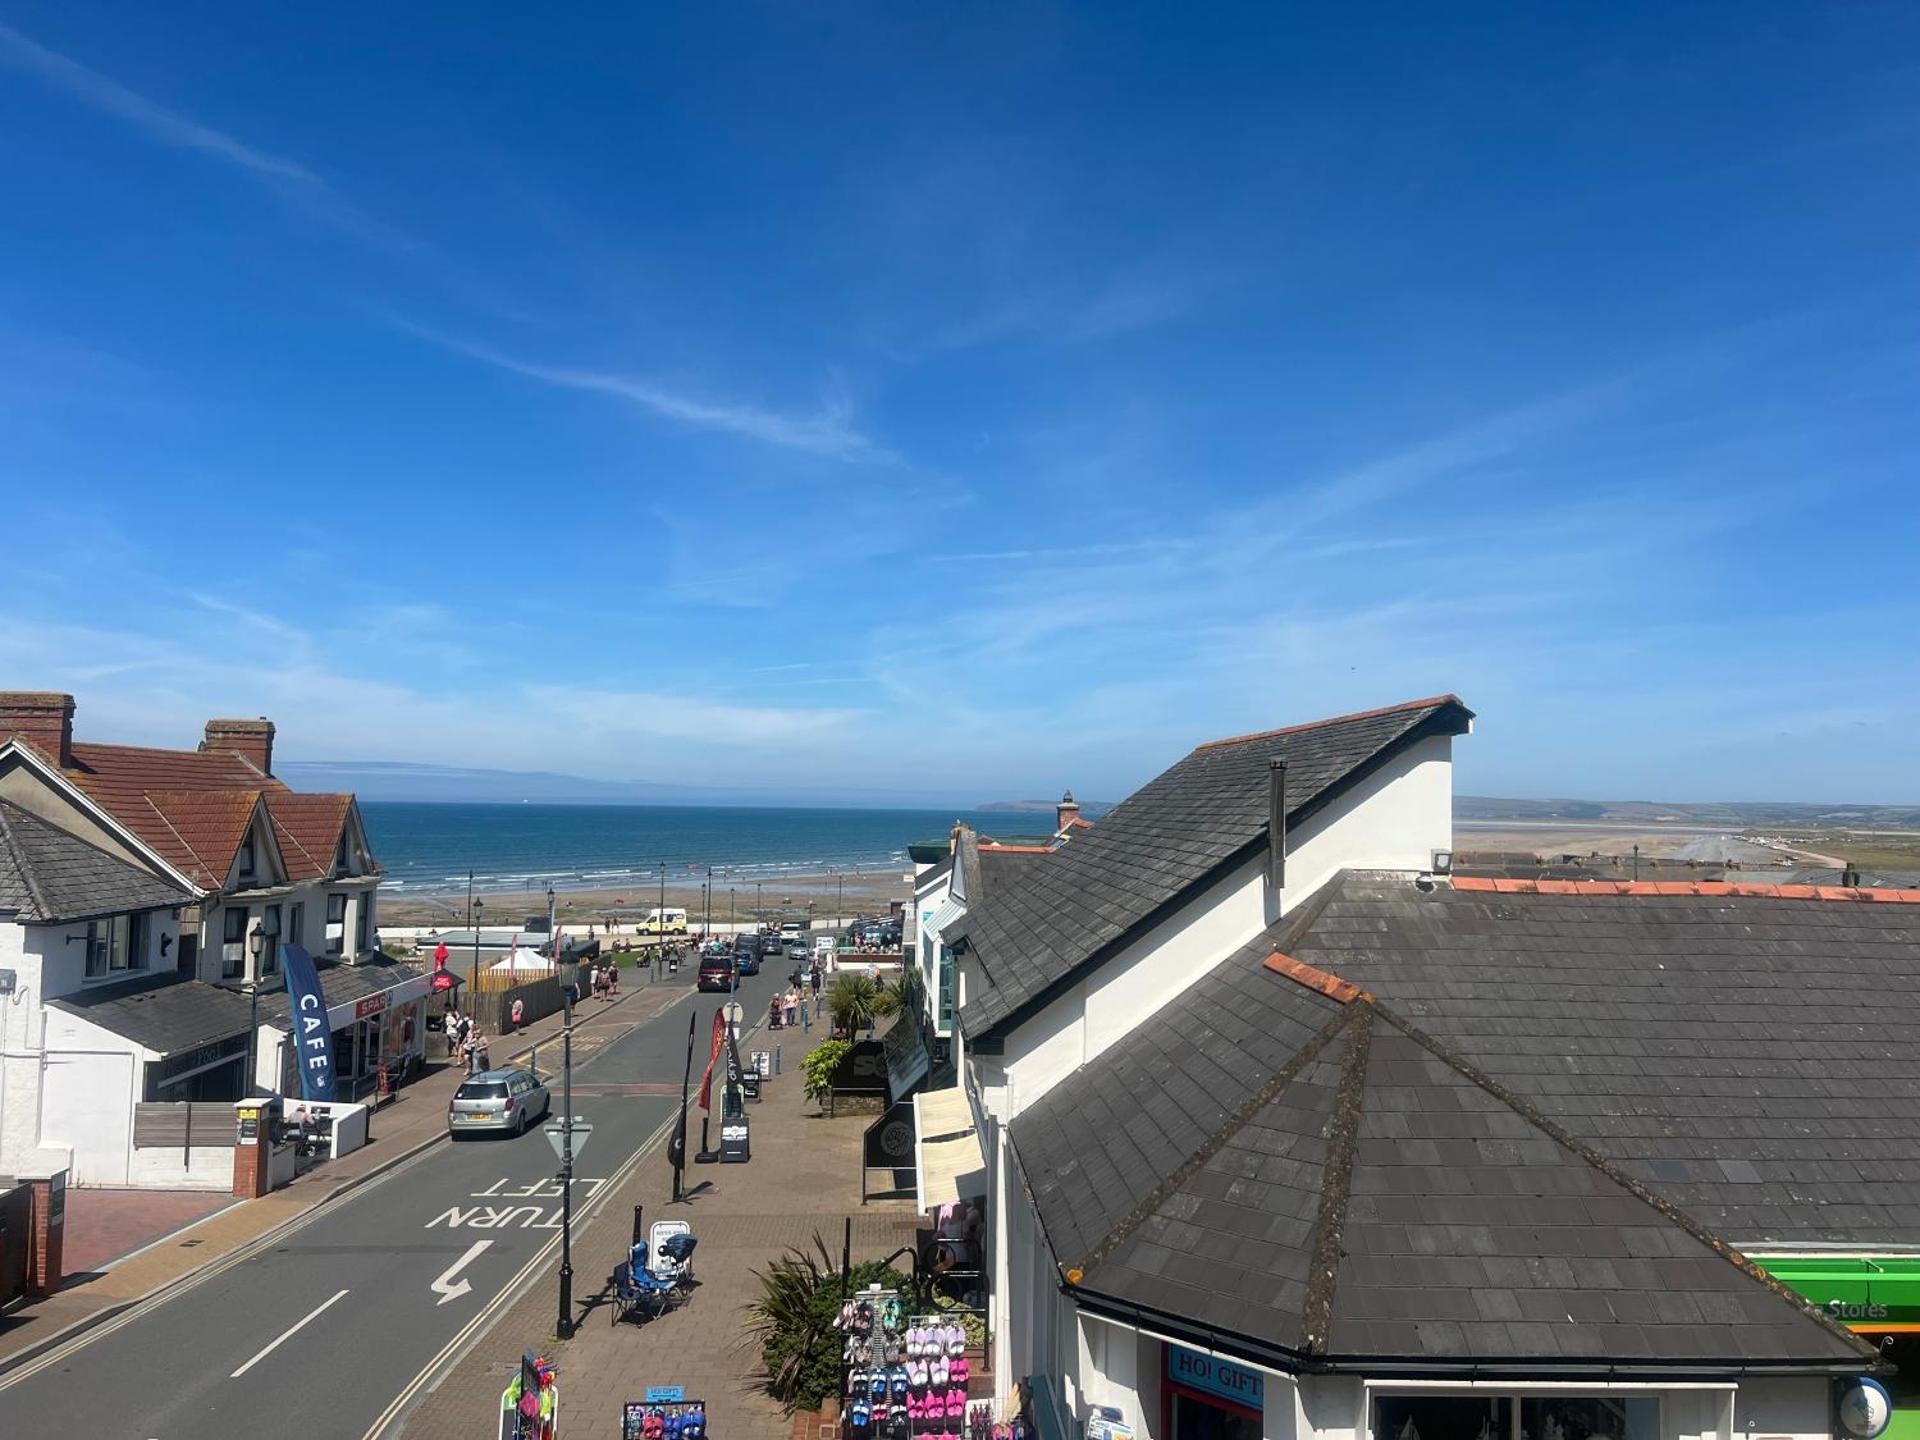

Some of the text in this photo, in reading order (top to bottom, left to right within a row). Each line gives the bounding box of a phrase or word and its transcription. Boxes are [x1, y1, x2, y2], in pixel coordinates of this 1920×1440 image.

[361, 997, 386, 1015] SPAR
[300, 993, 328, 1070] CAFE
[470, 1178, 607, 1198] LEFT
[424, 1206, 565, 1228] TURN
[1828, 1299, 1888, 1318] Stores
[1178, 1352, 1265, 1396] HO! GIFT
